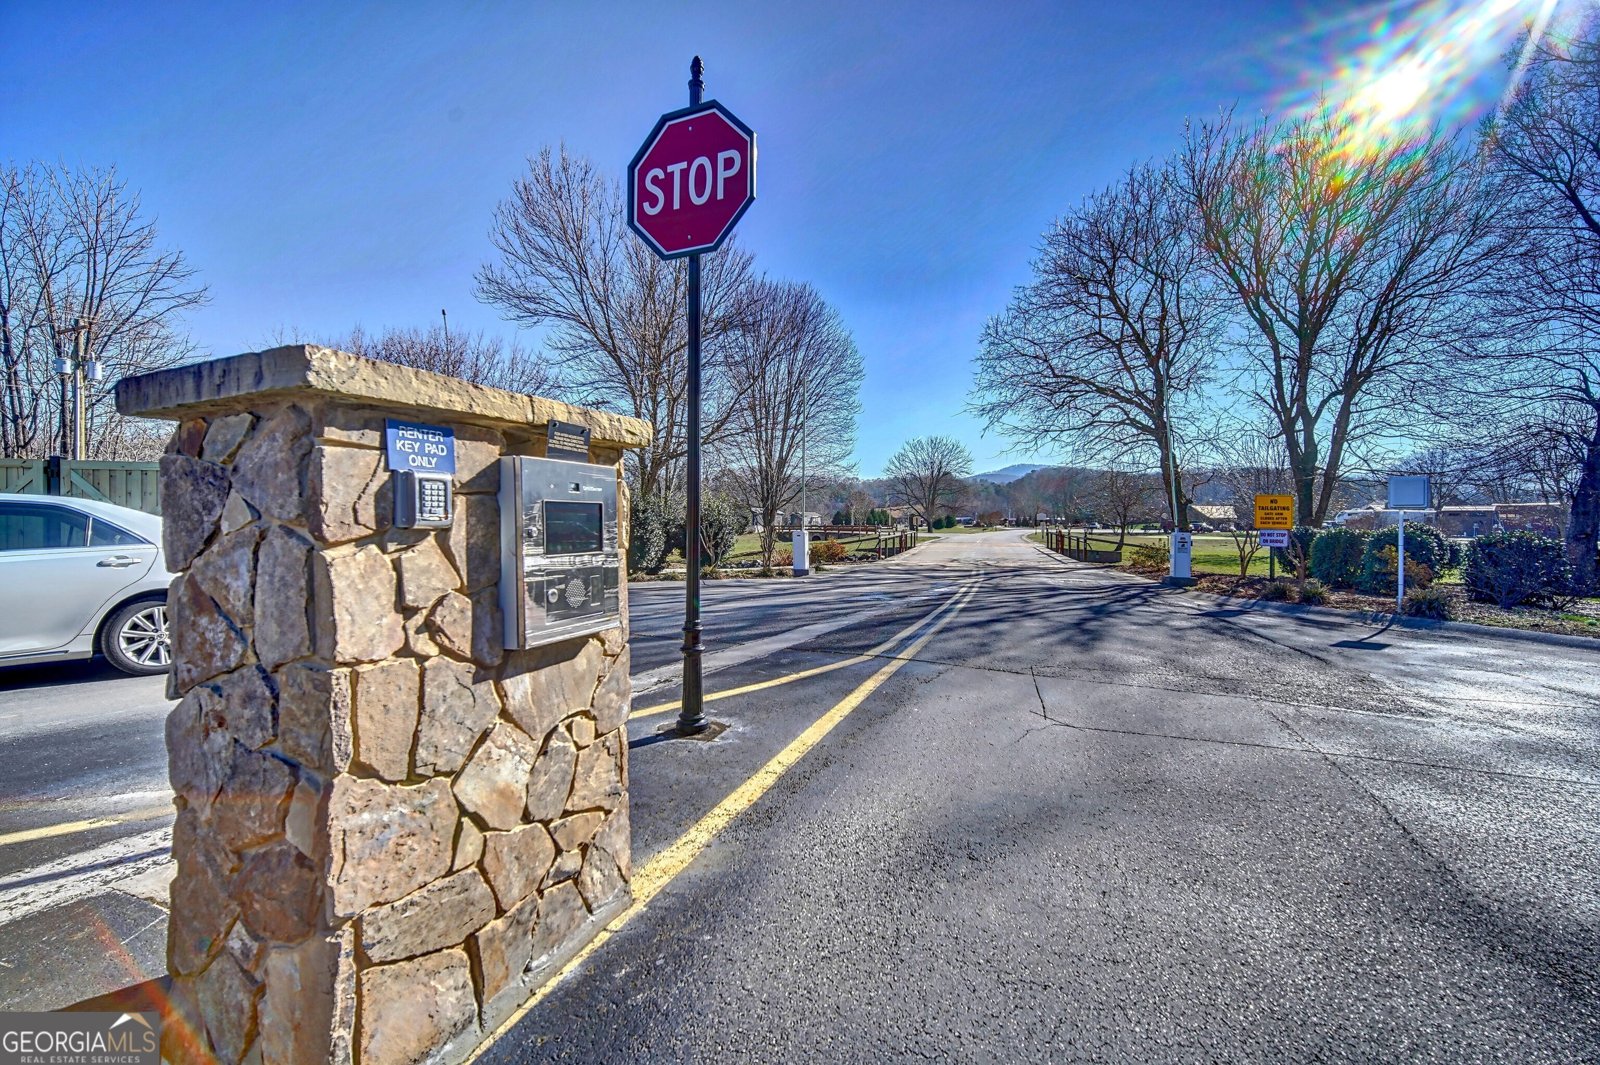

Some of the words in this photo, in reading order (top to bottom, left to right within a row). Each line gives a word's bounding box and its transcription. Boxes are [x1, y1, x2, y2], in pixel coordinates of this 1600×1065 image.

[643, 149, 741, 215] STOP
[399, 426, 443, 442] RENTER
[396, 440, 420, 452] KEY
[425, 443, 447, 455] PAD
[409, 454, 437, 467] ONLY
